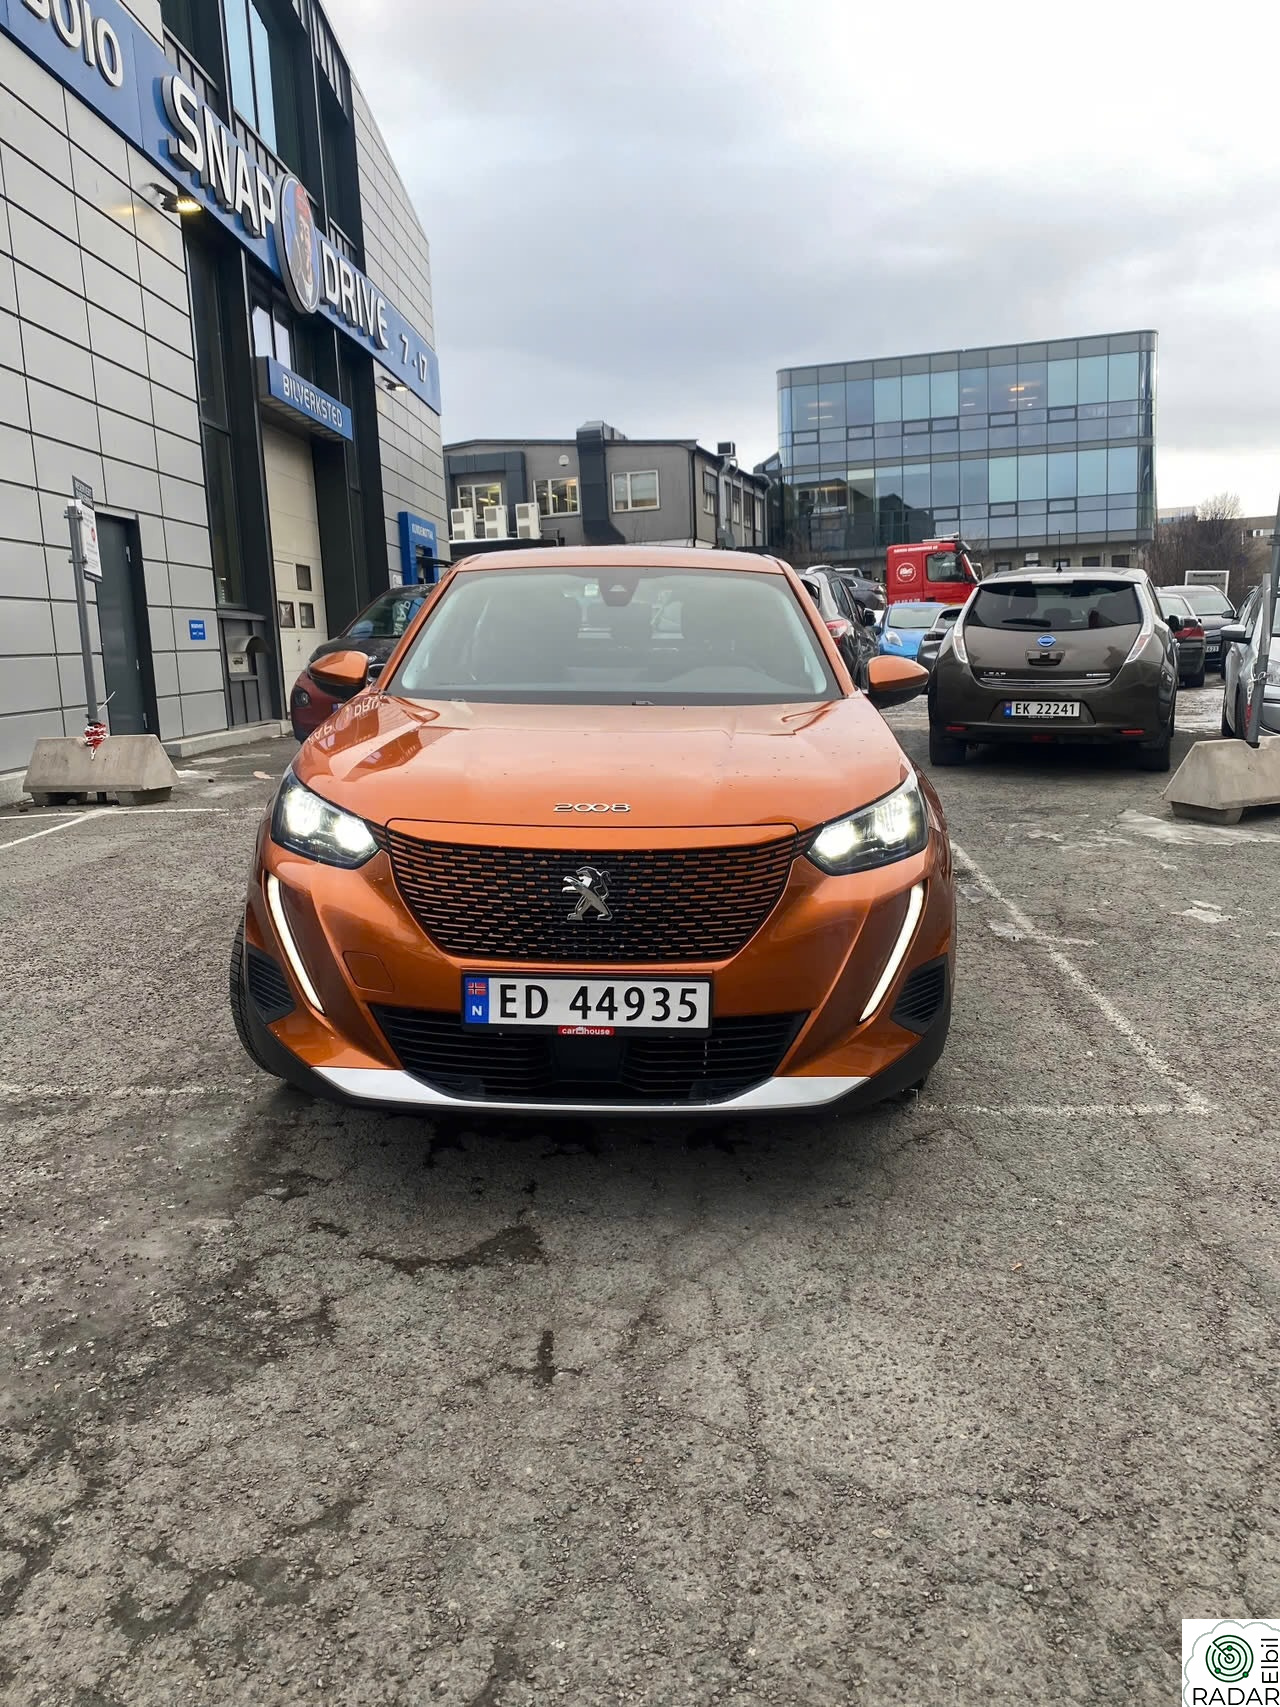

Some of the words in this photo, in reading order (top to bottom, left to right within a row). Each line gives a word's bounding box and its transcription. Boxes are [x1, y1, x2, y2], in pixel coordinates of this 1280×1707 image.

[163, 75, 276, 239] SNAP
[321, 240, 389, 350] DRIVE
[400, 333, 408, 364] 7
[417, 352, 427, 382] 17
[281, 372, 343, 428] BILVERKSTED
[1015, 703, 1030, 715] EK
[1037, 703, 1075, 715] 22241
[553, 803, 630, 812] 2008
[472, 1006, 482, 1016] N
[499, 984, 549, 1018] ED
[569, 986, 698, 1022] 44935
